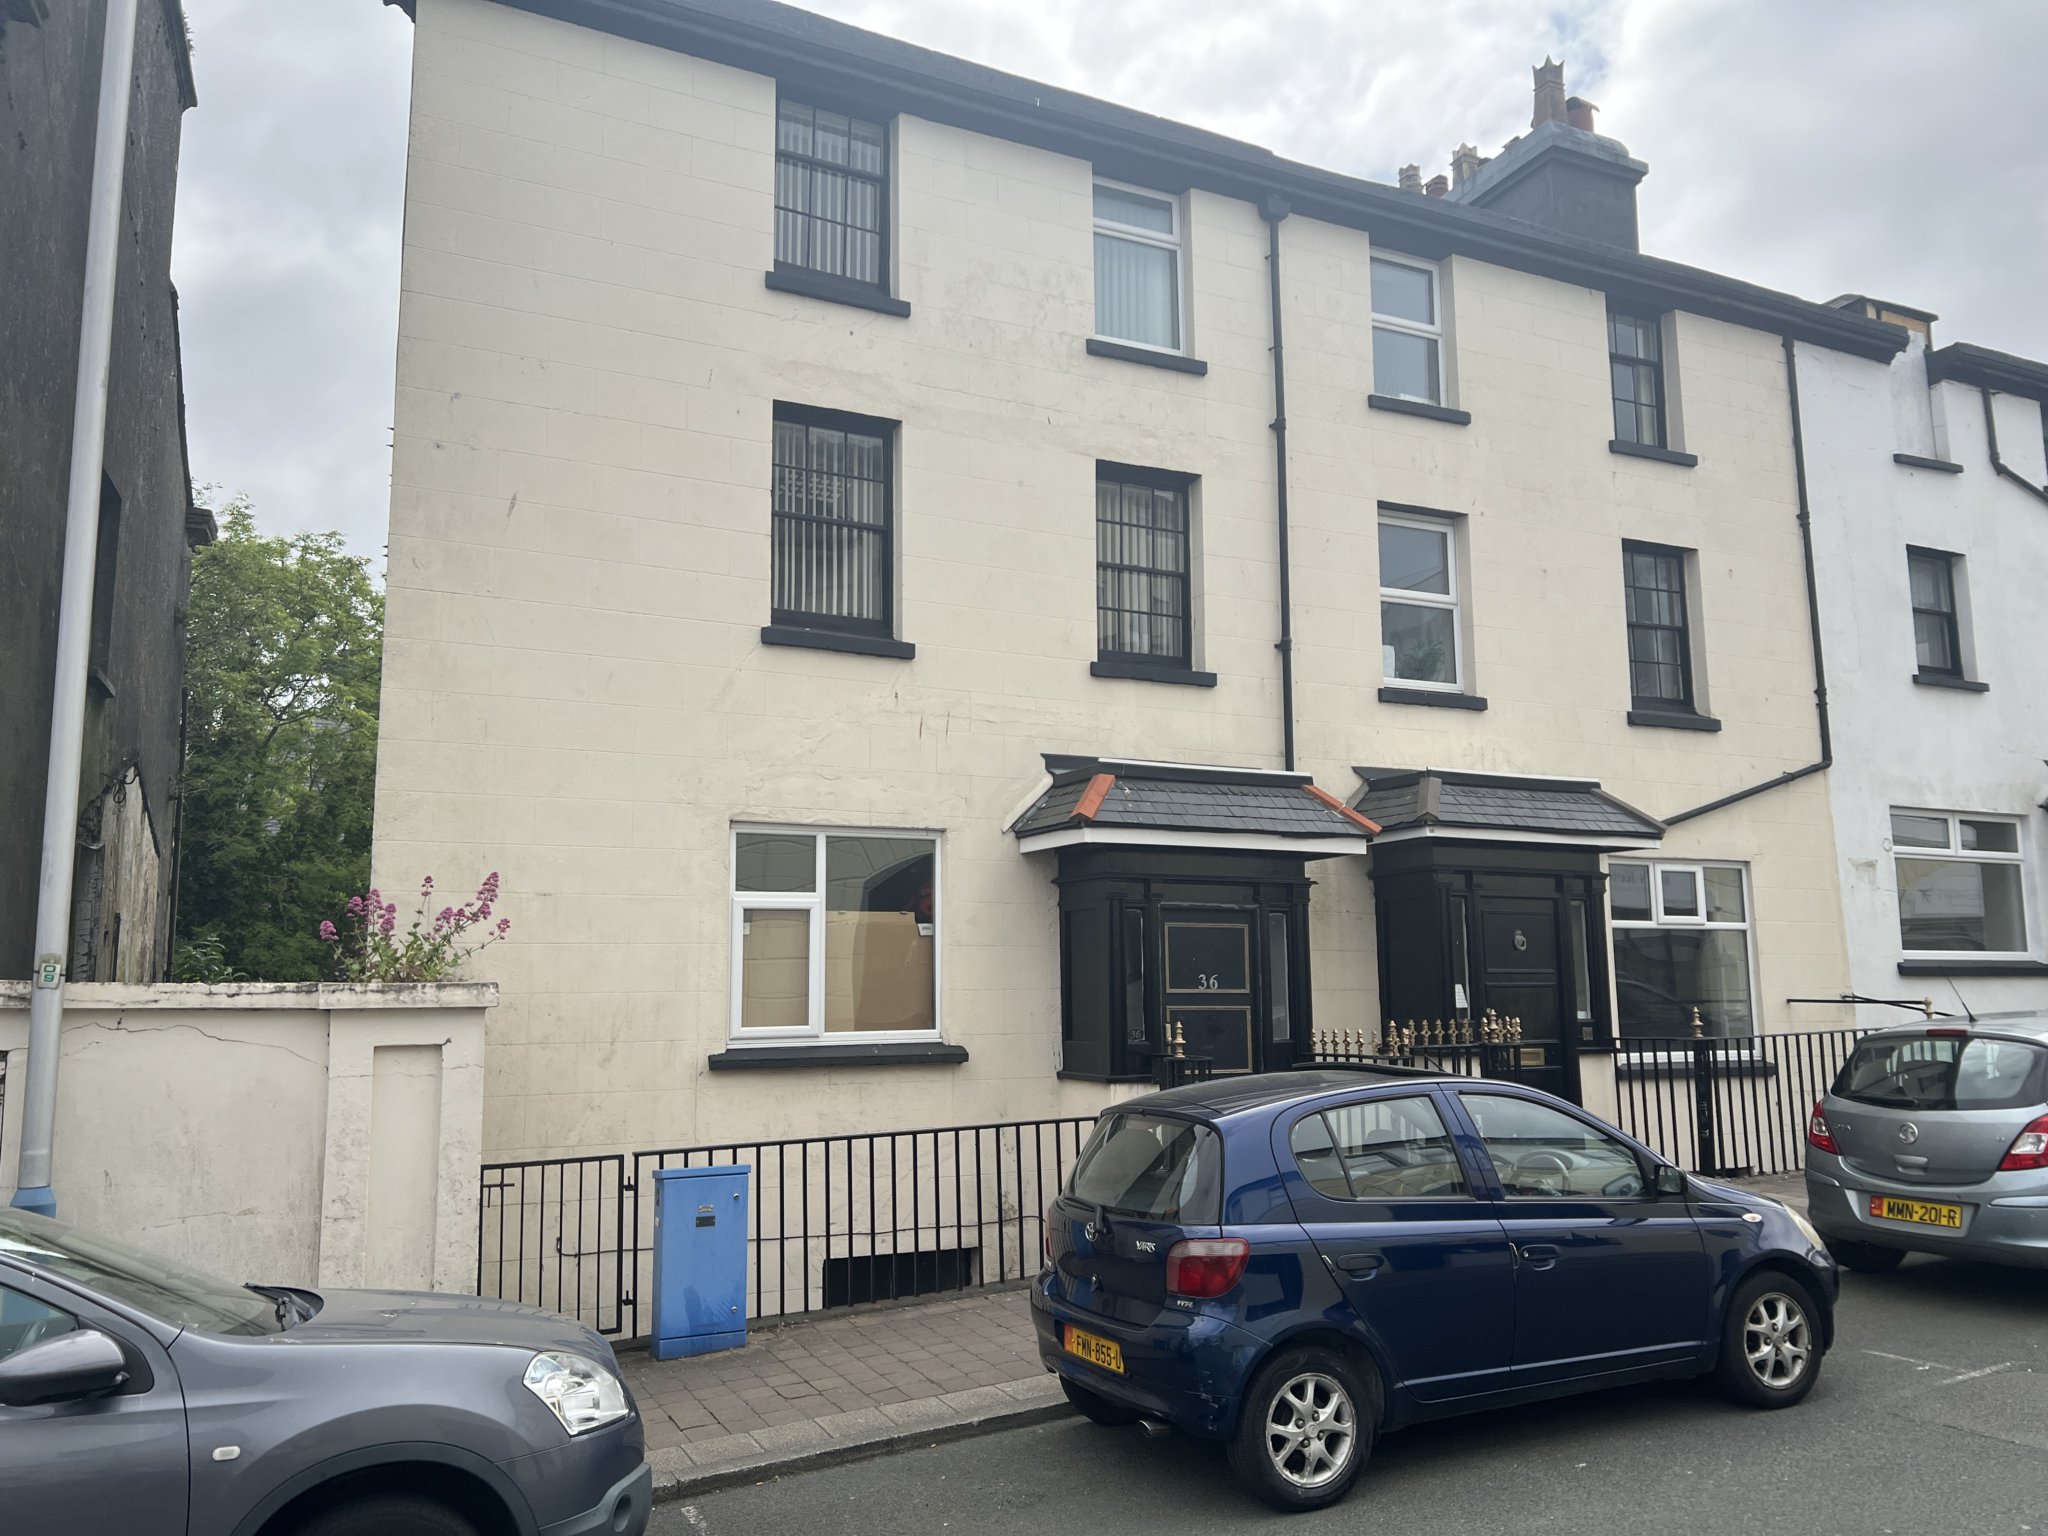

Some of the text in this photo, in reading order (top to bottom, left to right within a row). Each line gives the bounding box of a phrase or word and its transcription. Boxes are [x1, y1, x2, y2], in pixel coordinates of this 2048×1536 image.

[1198, 973, 1219, 990] 36
[1887, 1200, 1958, 1226] MMN-201-R
[1135, 1240, 1156, 1253] YARIS
[1076, 1334, 1122, 1370] FMN-855-U
